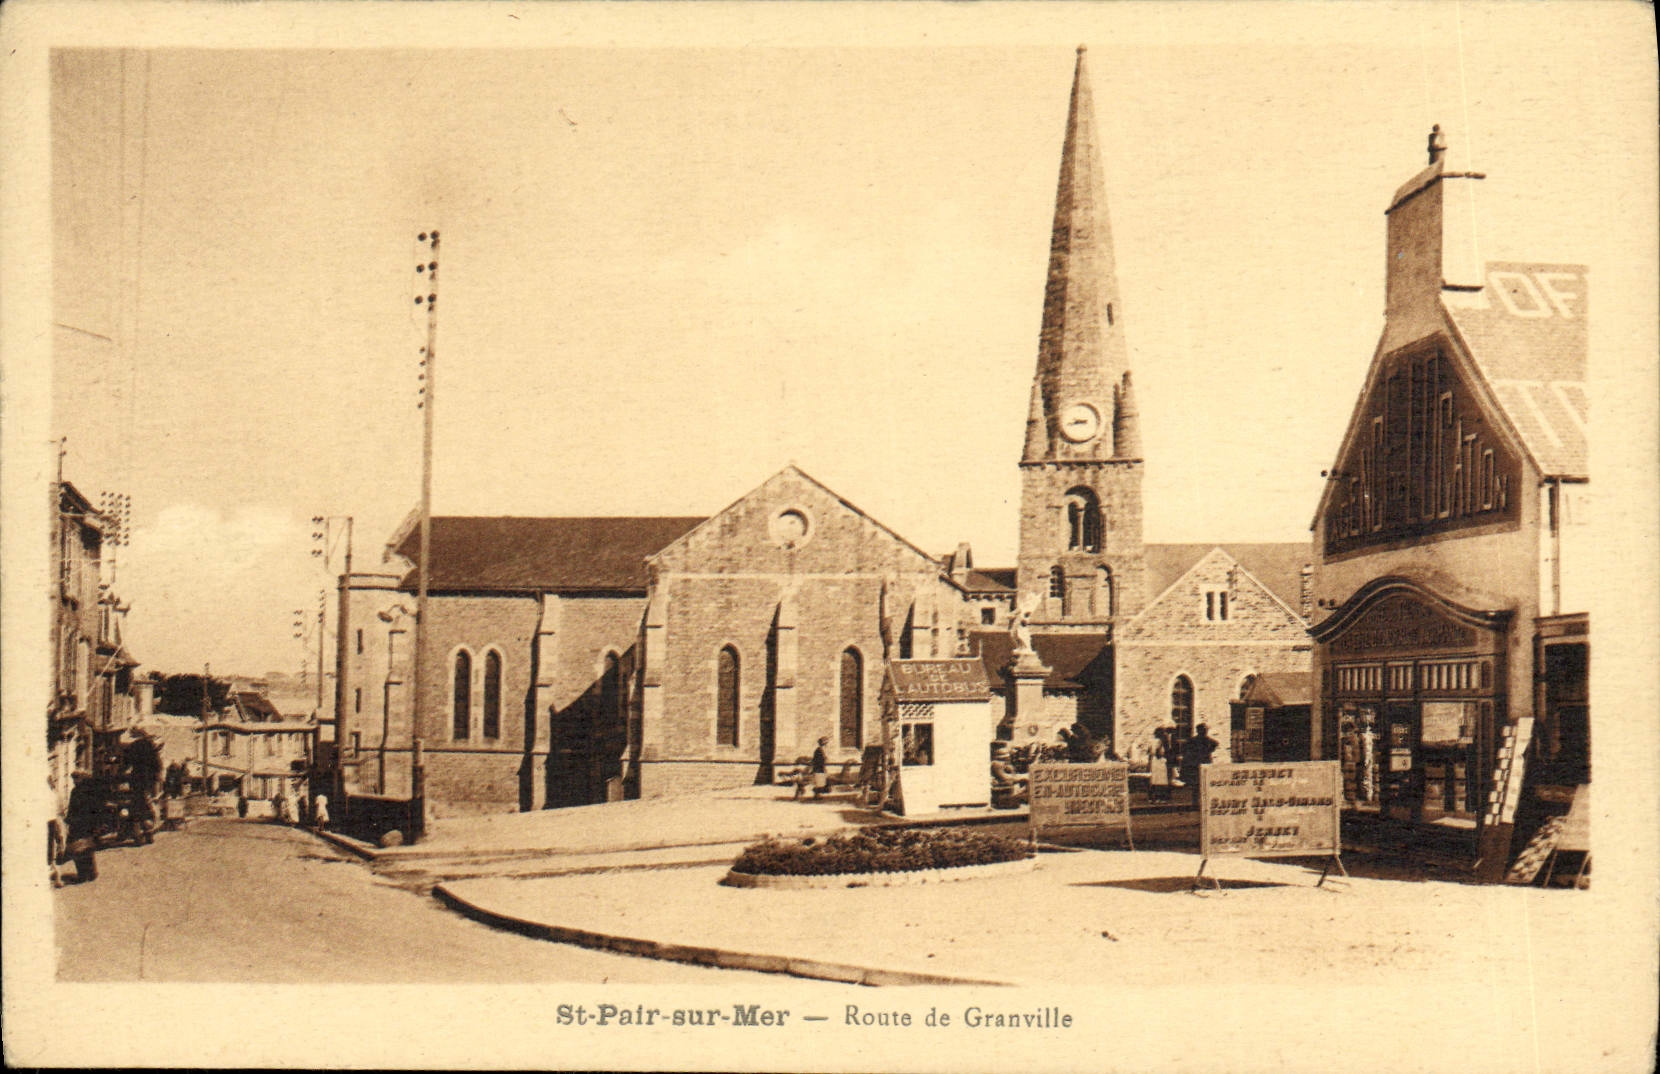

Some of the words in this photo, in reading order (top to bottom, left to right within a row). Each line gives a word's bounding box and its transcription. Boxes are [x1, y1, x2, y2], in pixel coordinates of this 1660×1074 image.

[1406, 352, 1509, 524] LOCATION
[902, 662, 972, 674] BUREAU
[1034, 768, 1126, 782] EXCURSIONS
[1246, 826, 1299, 837] JERSEY
